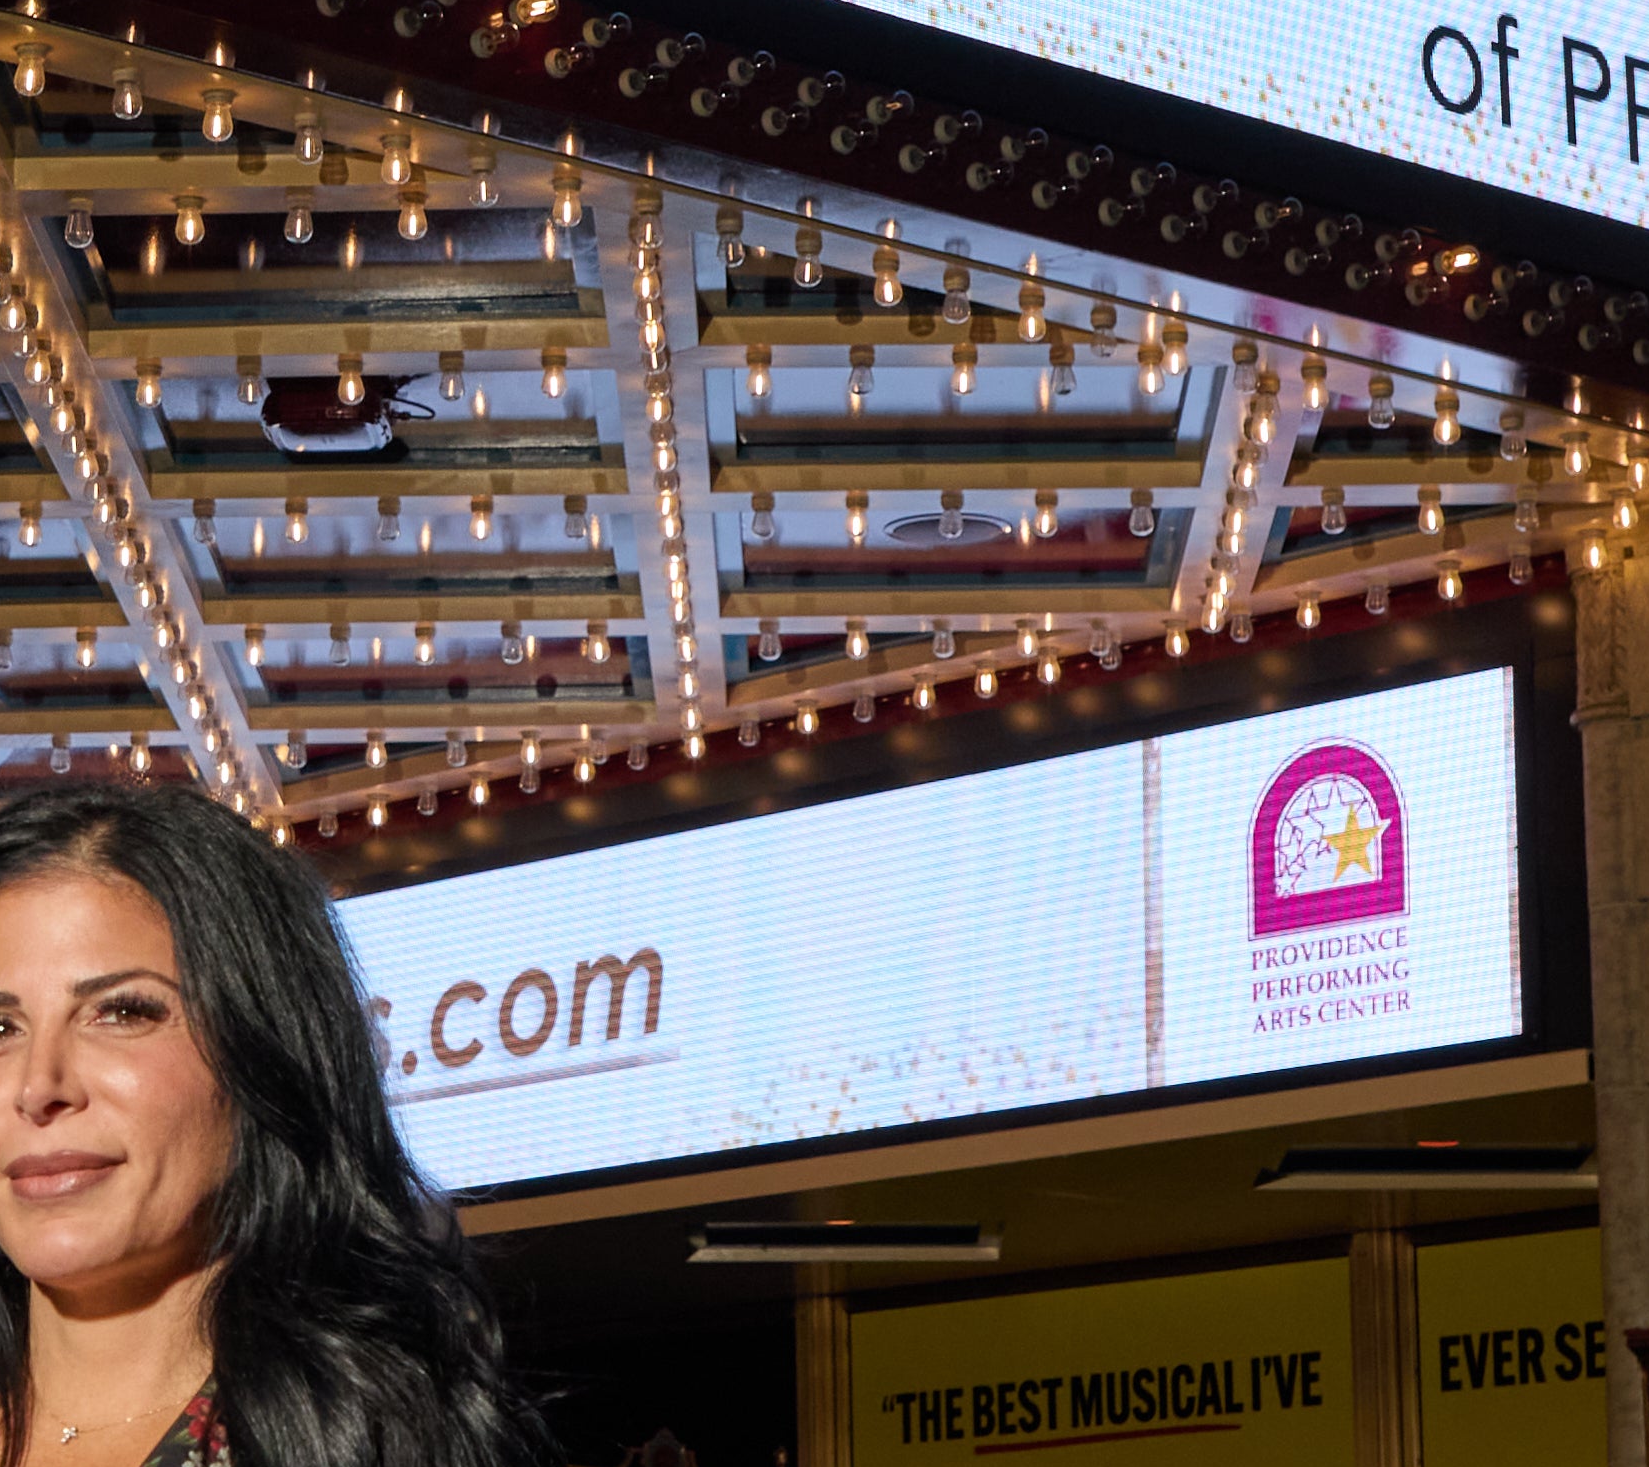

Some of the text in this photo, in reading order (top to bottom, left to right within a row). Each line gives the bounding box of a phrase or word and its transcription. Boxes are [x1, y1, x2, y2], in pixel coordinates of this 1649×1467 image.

[1422, 13, 1519, 126] of
[1251, 925, 1408, 971] PROVIDENCE
[1253, 958, 1409, 1003] PERFORMING
[1253, 989, 1411, 1034] ARTS CENTER
[1439, 1328, 1546, 1393] EVER
[972, 1377, 1064, 1437] BEST
[1070, 1360, 1245, 1428] MUSICAL
